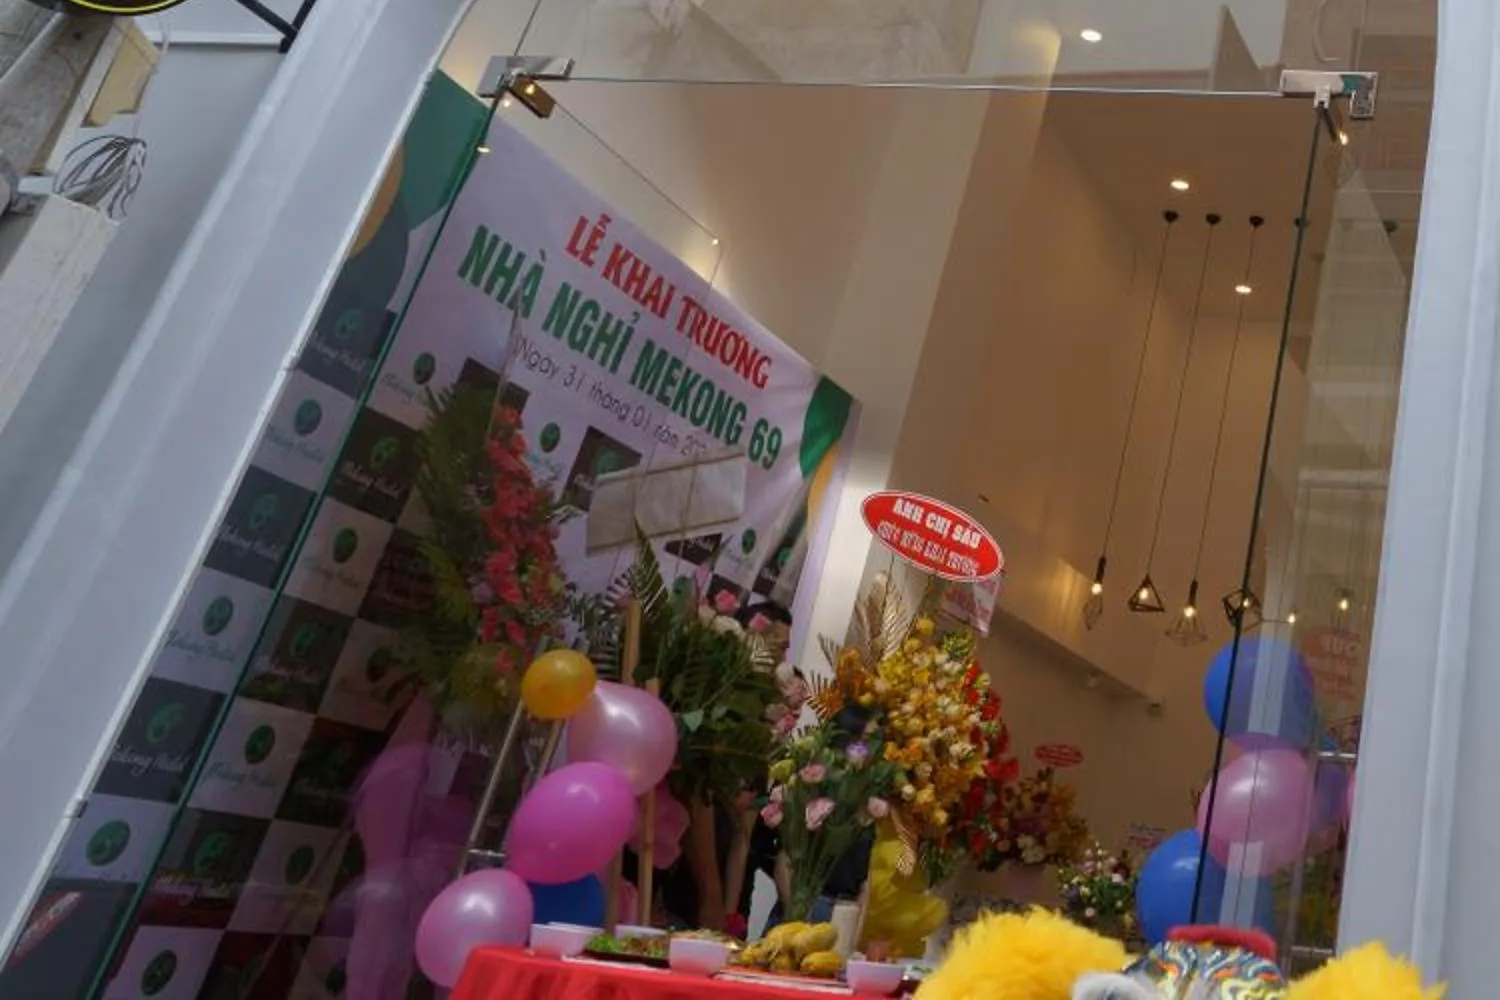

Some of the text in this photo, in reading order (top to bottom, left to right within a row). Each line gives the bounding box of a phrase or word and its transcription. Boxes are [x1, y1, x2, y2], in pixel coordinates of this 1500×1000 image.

[457, 224, 783, 471] NHÀ NGHỈ MEKONG 69
[565, 213, 772, 389] LỄ KHAI TRƯƠNG
